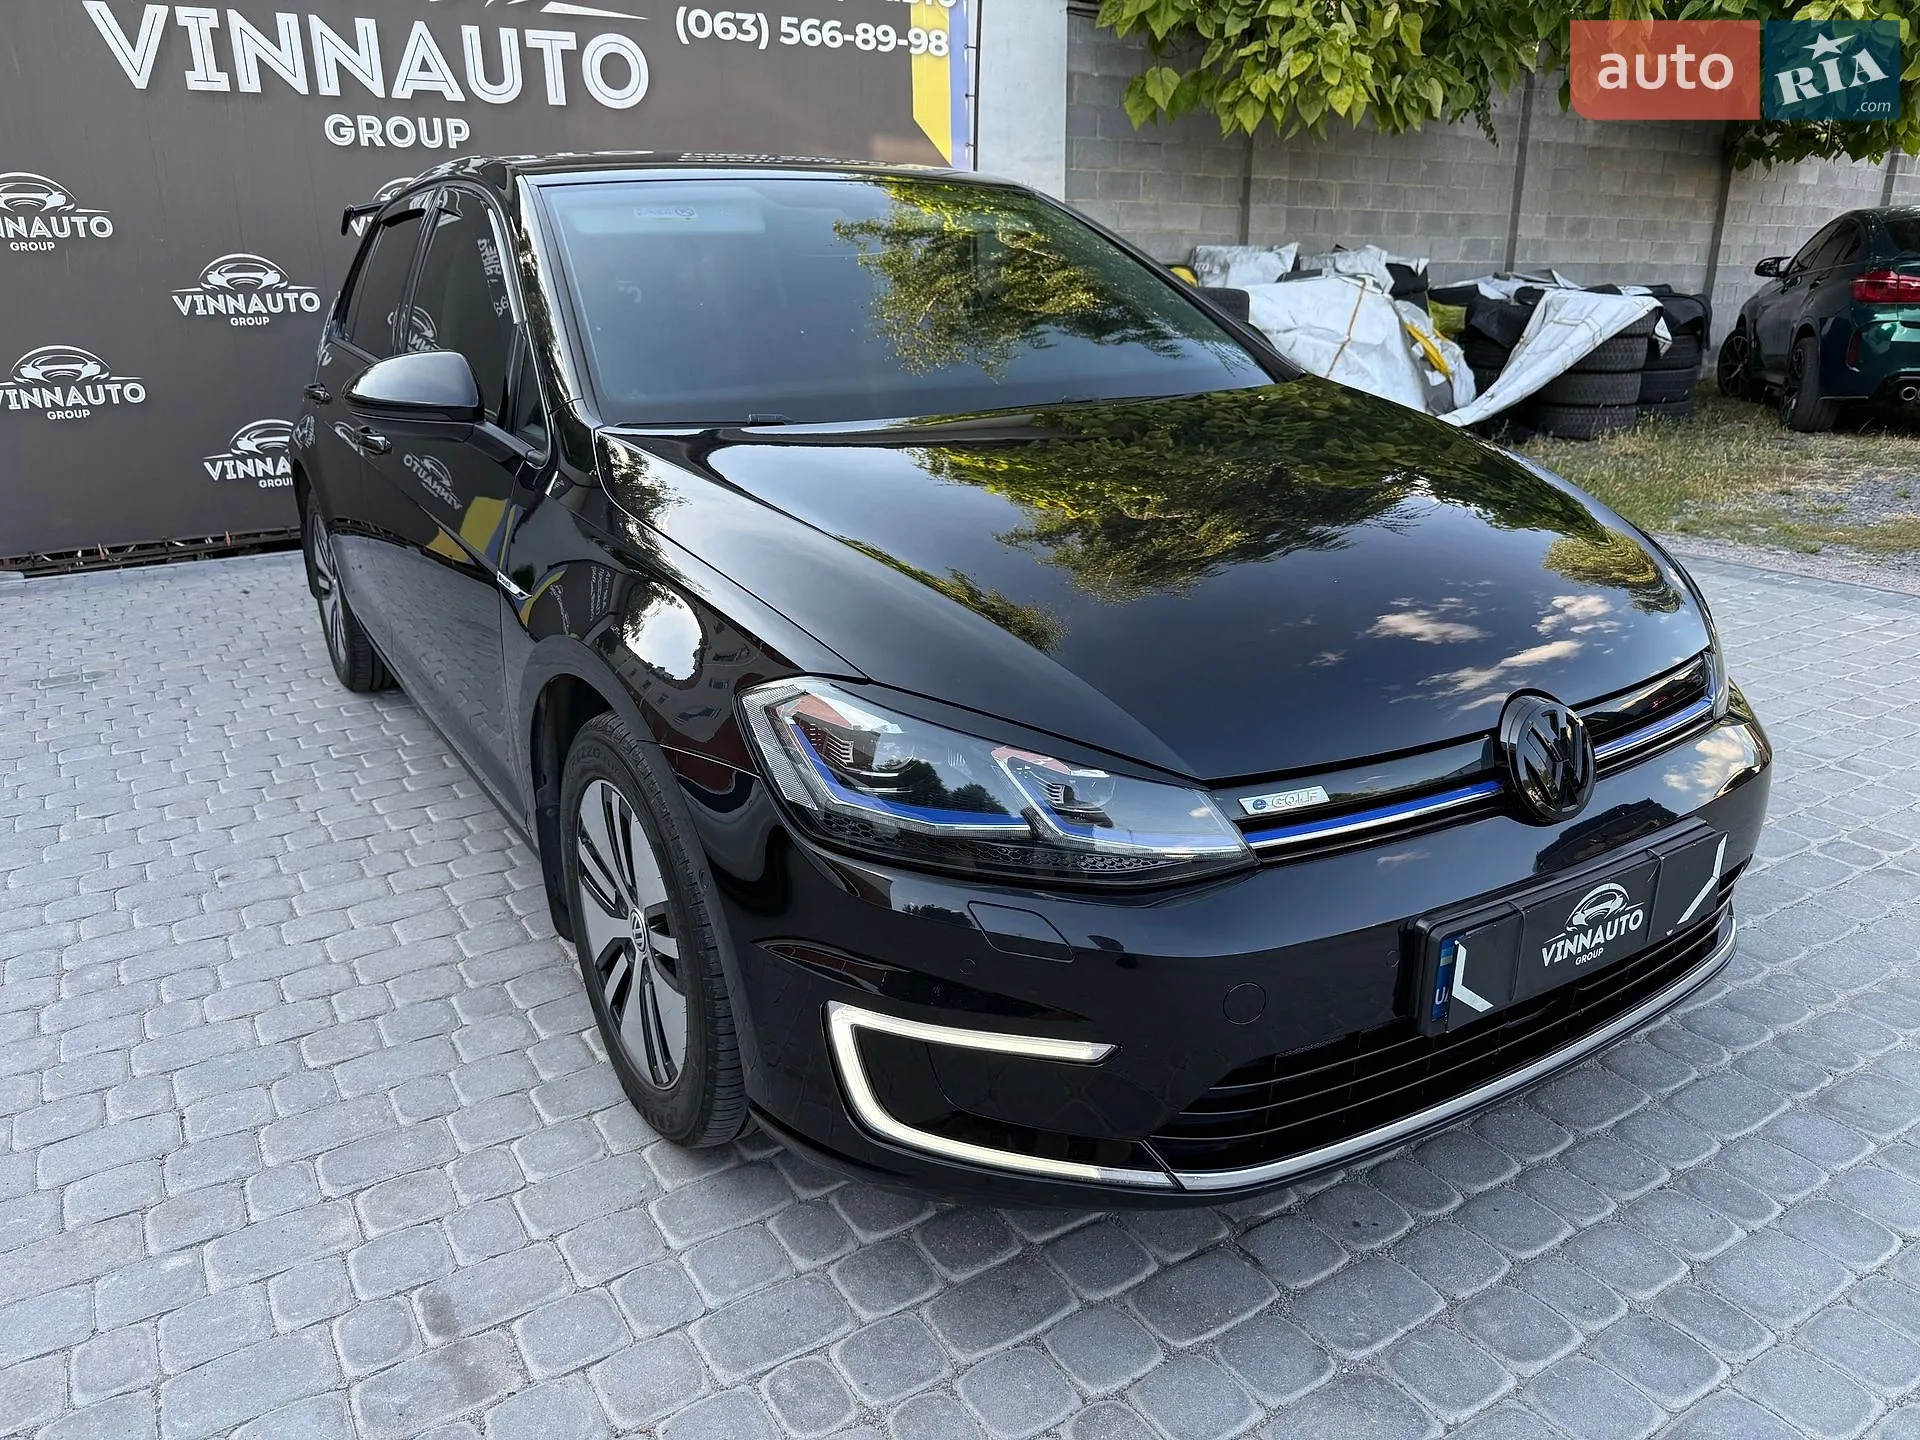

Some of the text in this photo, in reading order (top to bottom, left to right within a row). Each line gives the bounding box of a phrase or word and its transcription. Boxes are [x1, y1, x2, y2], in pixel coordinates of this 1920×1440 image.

[675, 6, 949, 56] (063) 566-89-98
[83, 0, 649, 110] VINNAUTO
[324, 113, 470, 149] GROUP
[0, 215, 114, 238] NAUTO
[9, 241, 56, 251] GROUP
[172, 292, 321, 316] VINNAUTO
[230, 316, 270, 326] GROUP
[0, 382, 146, 410] INNAUTO
[47, 409, 91, 420] GROUP
[203, 456, 292, 481] VINNA
[1542, 908, 1644, 967] VINNAUTO
[1575, 947, 1604, 966] GROUP
